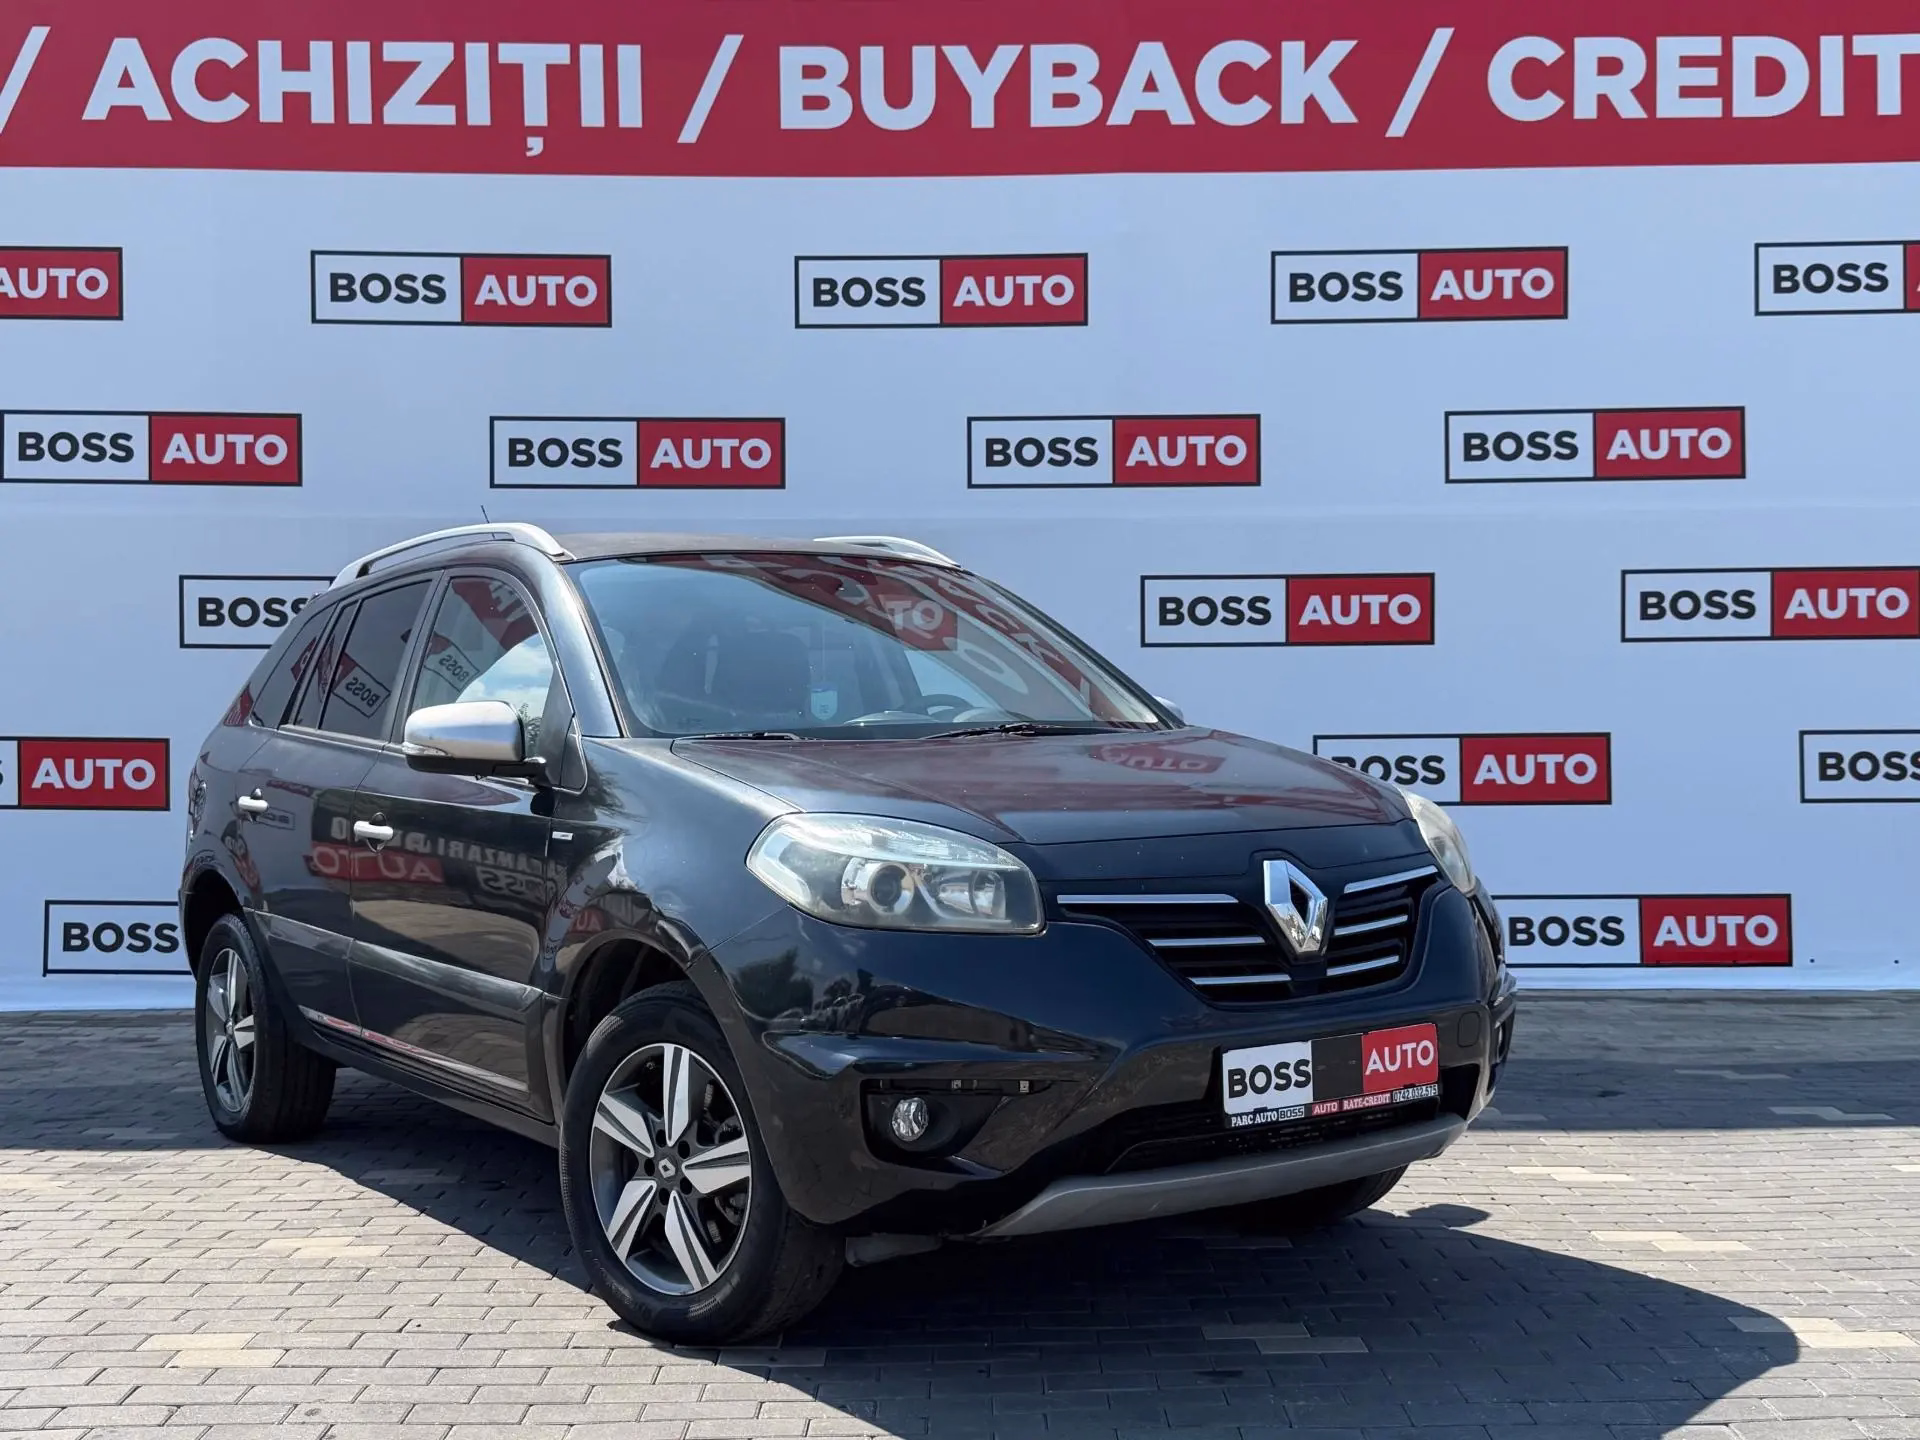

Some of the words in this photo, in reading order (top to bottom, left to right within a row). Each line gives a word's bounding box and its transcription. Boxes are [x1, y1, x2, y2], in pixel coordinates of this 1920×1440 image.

[678, 35, 744, 143] /
[780, 41, 1358, 130] BUYBACK
[1386, 28, 1454, 137] /
[1488, 34, 1920, 121] CREDIT
[329, 272, 447, 304] BOSS
[475, 275, 598, 307] AUTO
[813, 277, 926, 307] BOSS
[953, 275, 1075, 307] AUTO
[1289, 272, 1403, 302] BOSS
[1431, 268, 1555, 301] AUTO
[1773, 263, 1889, 294] BOSS
[18, 432, 135, 463] BOSS
[163, 434, 288, 466] AUTO
[508, 438, 623, 468] BOSS
[650, 438, 772, 469] AUTO
[985, 437, 1099, 468] BOSS
[1125, 435, 1247, 467] AUTO
[1463, 431, 1579, 462] BOSS
[1607, 427, 1732, 460] AUTO
[1158, 596, 1272, 627] BOSS
[1298, 594, 1421, 626] AUTO
[1639, 590, 1756, 621] BOSS
[1784, 587, 1910, 619] AUTO
[31, 758, 156, 790] AUTO
[1332, 756, 1446, 785] OSS
[1473, 753, 1597, 785] AUTO
[62, 922, 180, 954] BOSS
[1508, 916, 1625, 947] BOSS
[1653, 914, 1778, 947] AUTO
[1227, 1058, 1312, 1099] BOSS
[1364, 1039, 1435, 1076] AUTO
[1231, 1114, 1254, 1127] PARC
[1255, 1110, 1278, 1124] AUTO
[1279, 1107, 1304, 1119] BOSS
[1313, 1102, 1338, 1115] AUTO
